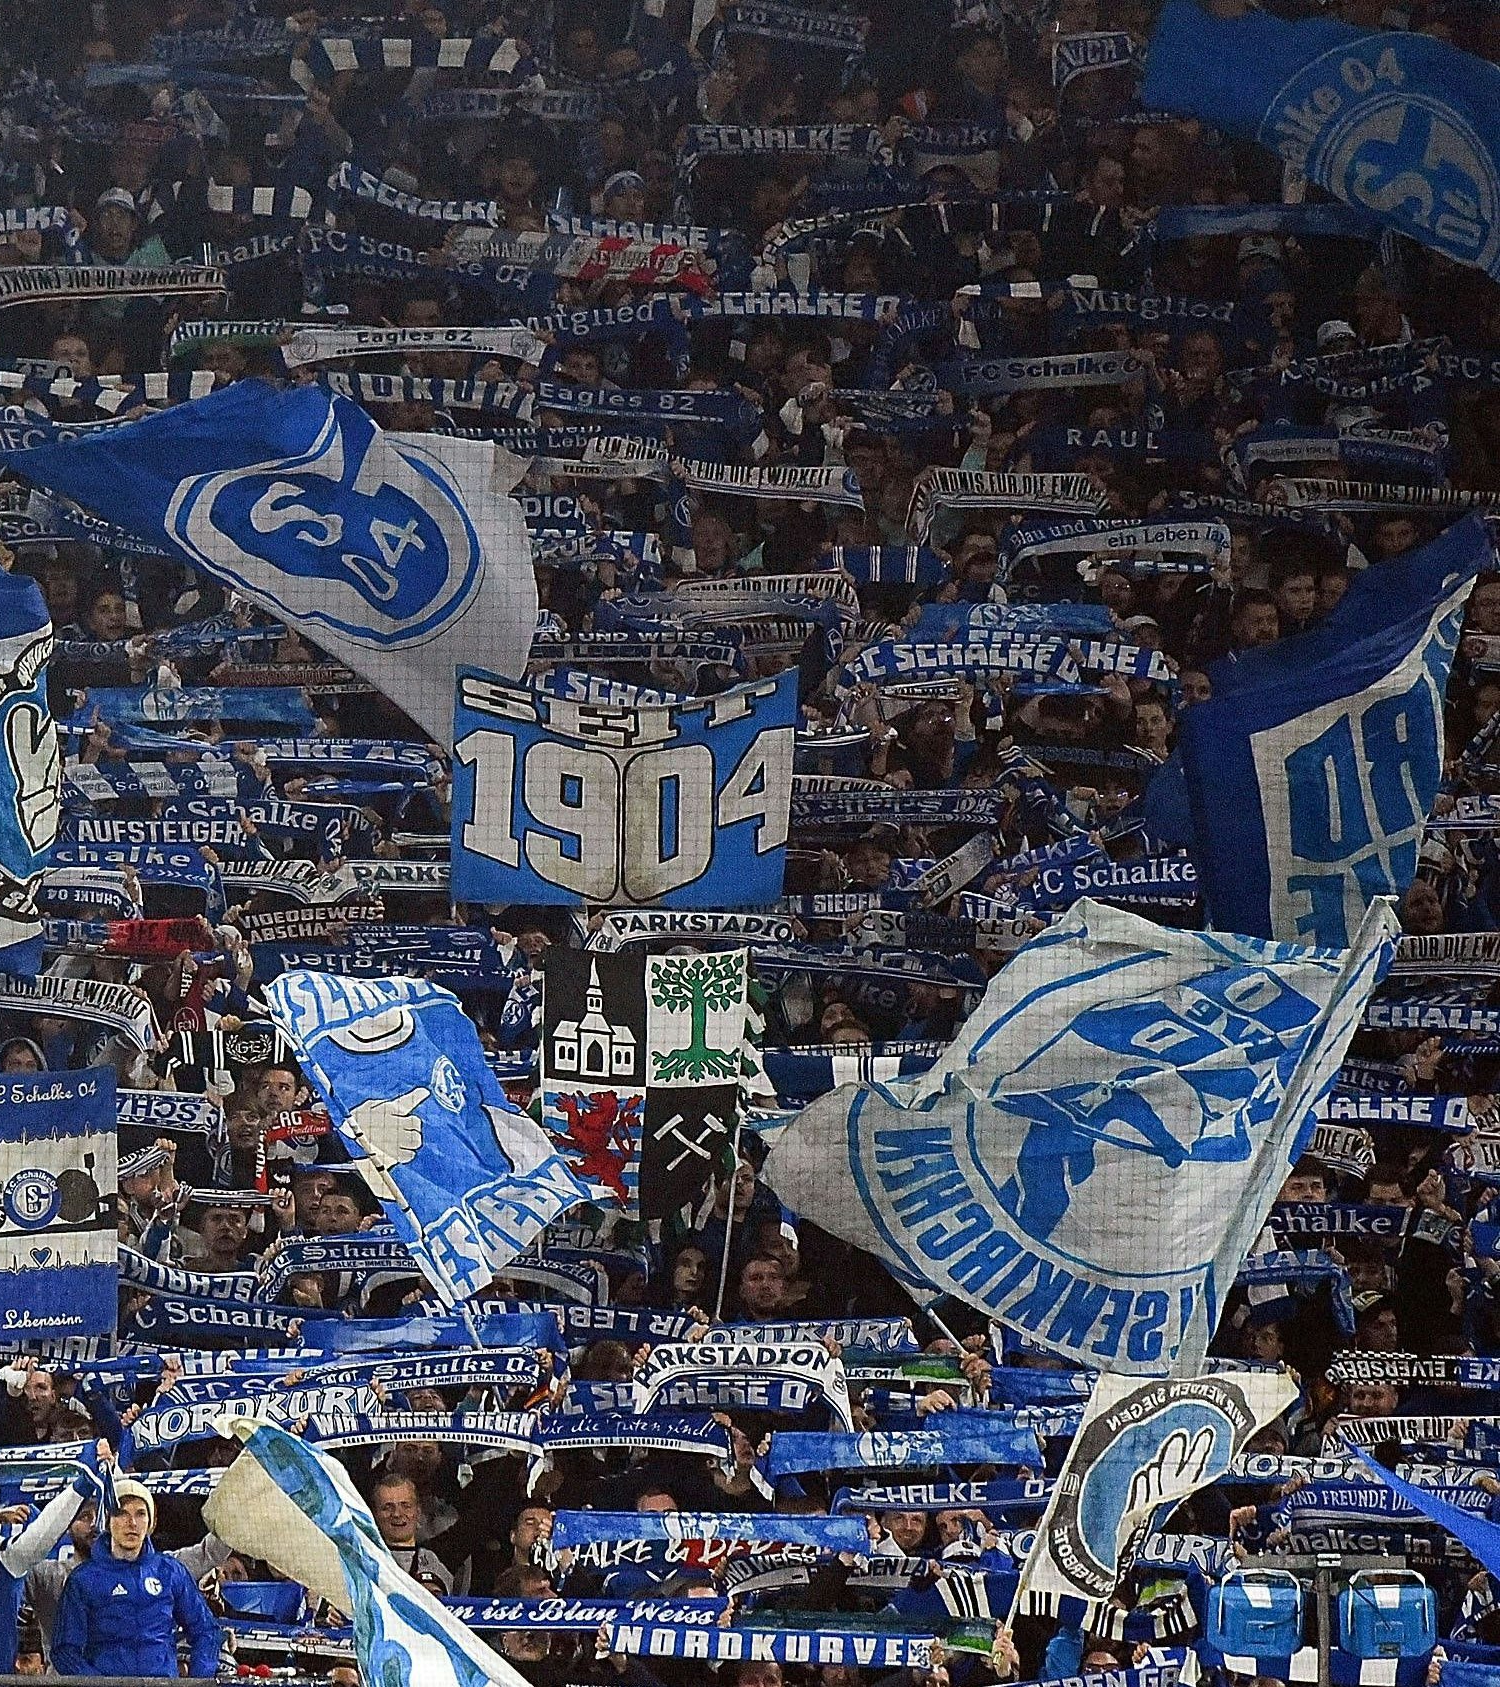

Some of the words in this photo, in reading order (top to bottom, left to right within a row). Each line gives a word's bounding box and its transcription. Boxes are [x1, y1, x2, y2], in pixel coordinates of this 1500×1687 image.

[1276, 86, 1341, 160] alke
[1342, 48, 1405, 93] 04
[698, 127, 854, 150] SCHALKE
[360, 171, 505, 228] SCHALKE
[311, 228, 347, 253] FC
[550, 213, 708, 249] SCHALKE
[702, 291, 867, 317] SCHALKE
[1071, 289, 1236, 324] Mitglied
[508, 301, 656, 338] Mitglied
[357, 327, 440, 345] Eagles
[444, 328, 474, 343] 82
[1005, 354, 1117, 378] Schalke
[539, 382, 642, 411] Eagles
[659, 393, 696, 412] 82
[8, 426, 46, 451] FC
[758, 465, 836, 488] EWIGKEIT
[1023, 474, 1047, 496] DIE
[1050, 520, 1085, 539] und
[1107, 531, 1138, 549] ein
[1142, 526, 1200, 544] Leben
[578, 630, 628, 644] UND
[461, 676, 778, 748] SEIT
[186, 799, 320, 831] Schalke
[454, 726, 796, 904] 1904
[76, 818, 248, 847] AUFSTEIGER!
[1073, 860, 1198, 889] Schalke
[240, 905, 380, 930] VIDEOBEWEIS
[1407, 938, 1441, 960] FÜR
[1443, 938, 1467, 958] DIE
[42, 976, 70, 998] DIE
[72, 979, 147, 1019] EWIGKEIT
[235, 1039, 262, 1056] GE
[11, 1083, 74, 1104] Schalke
[76, 1080, 98, 1100] 04
[168, 1301, 305, 1330] Schalke
[372, 1355, 502, 1379] Schalke
[634, 1344, 830, 1389] PARKSTADION
[1323, 1358, 1447, 1386] ELVERSBERG
[312, 1411, 369, 1436] WIR
[372, 1411, 459, 1431] WERDEN
[462, 1411, 532, 1435] SIEGEN
[571, 1417, 600, 1433] die
[1343, 1419, 1418, 1445] BÜNDNIS
[849, 1480, 990, 1503] SCHALKE
[1322, 1488, 1390, 1512] FREUNDE
[665, 1539, 689, 1564] &
[1403, 1531, 1433, 1553] in
[481, 1594, 522, 1624] ist
[528, 1598, 620, 1623] Blau
[625, 1599, 716, 1628] Weiss
[614, 1623, 907, 1667] NORDKURVE
